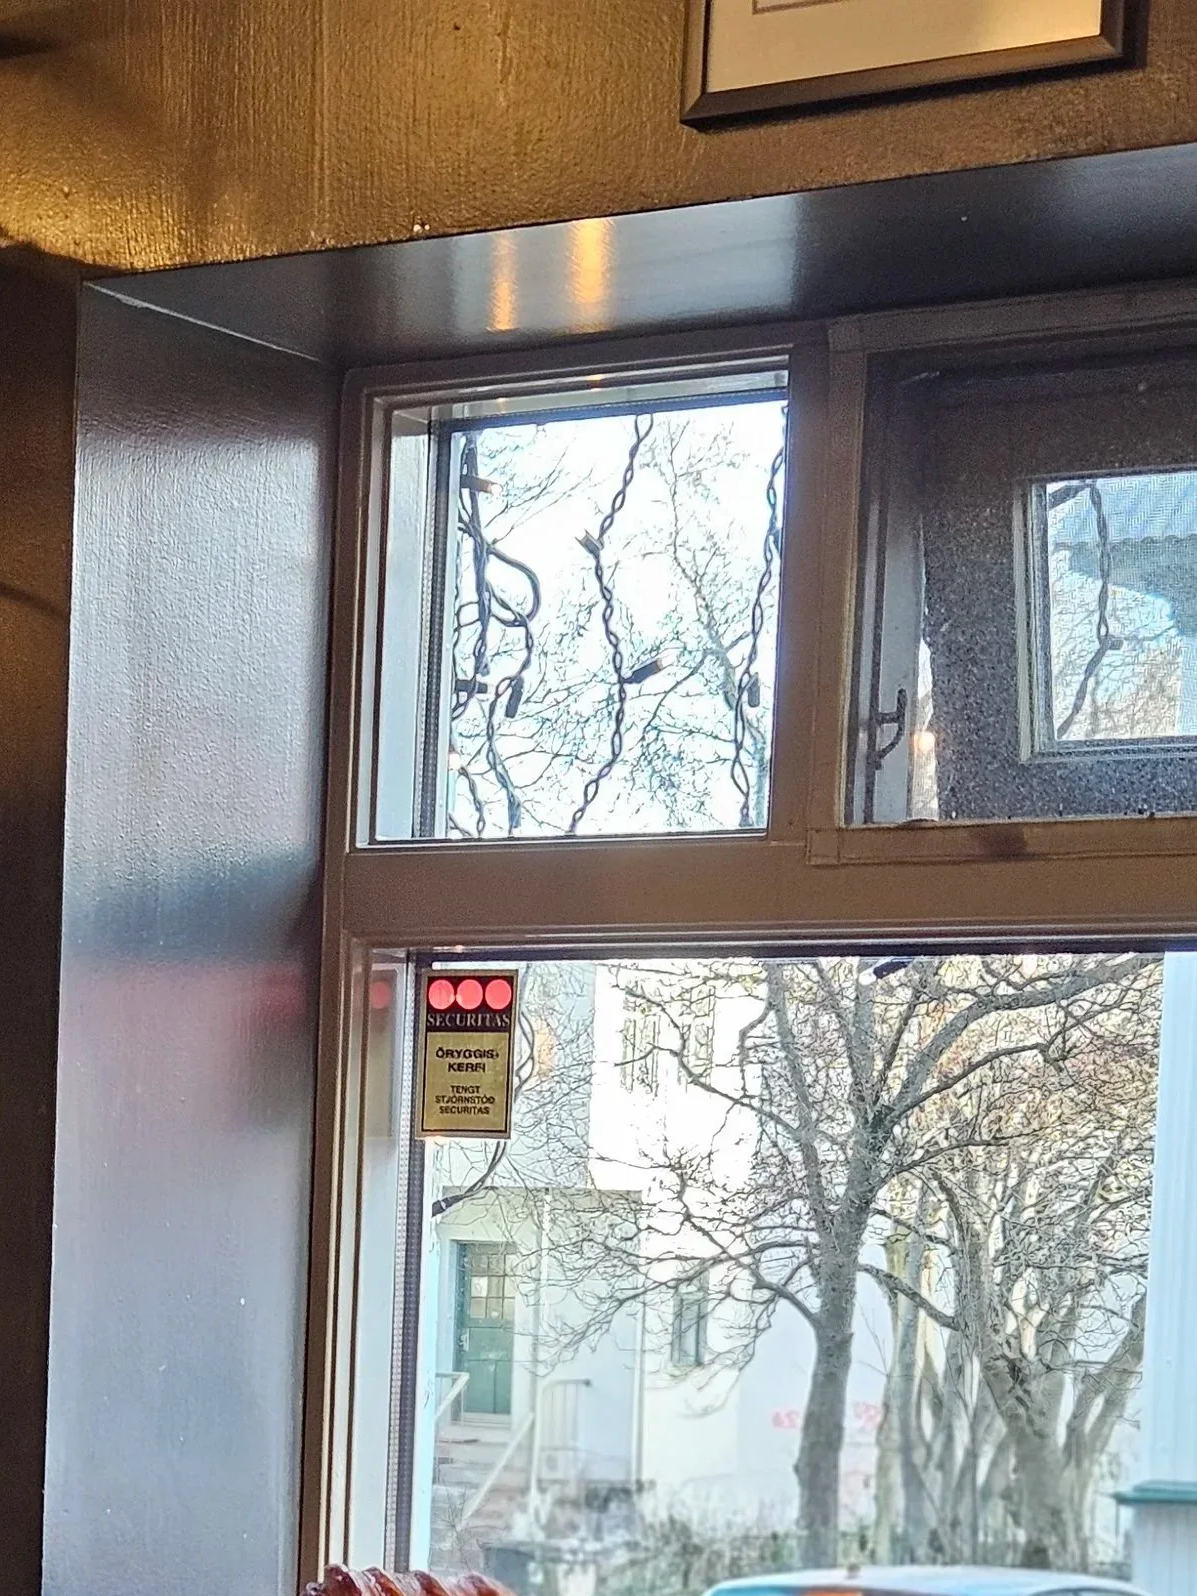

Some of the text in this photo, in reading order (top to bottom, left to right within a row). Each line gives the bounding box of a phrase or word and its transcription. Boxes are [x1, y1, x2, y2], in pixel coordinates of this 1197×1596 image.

[427, 1012, 510, 1028] SECURITAS
[448, 1062, 486, 1073] KERFI
[450, 1085, 481, 1094] TENGT
[439, 1105, 490, 1115] SECURITAS
